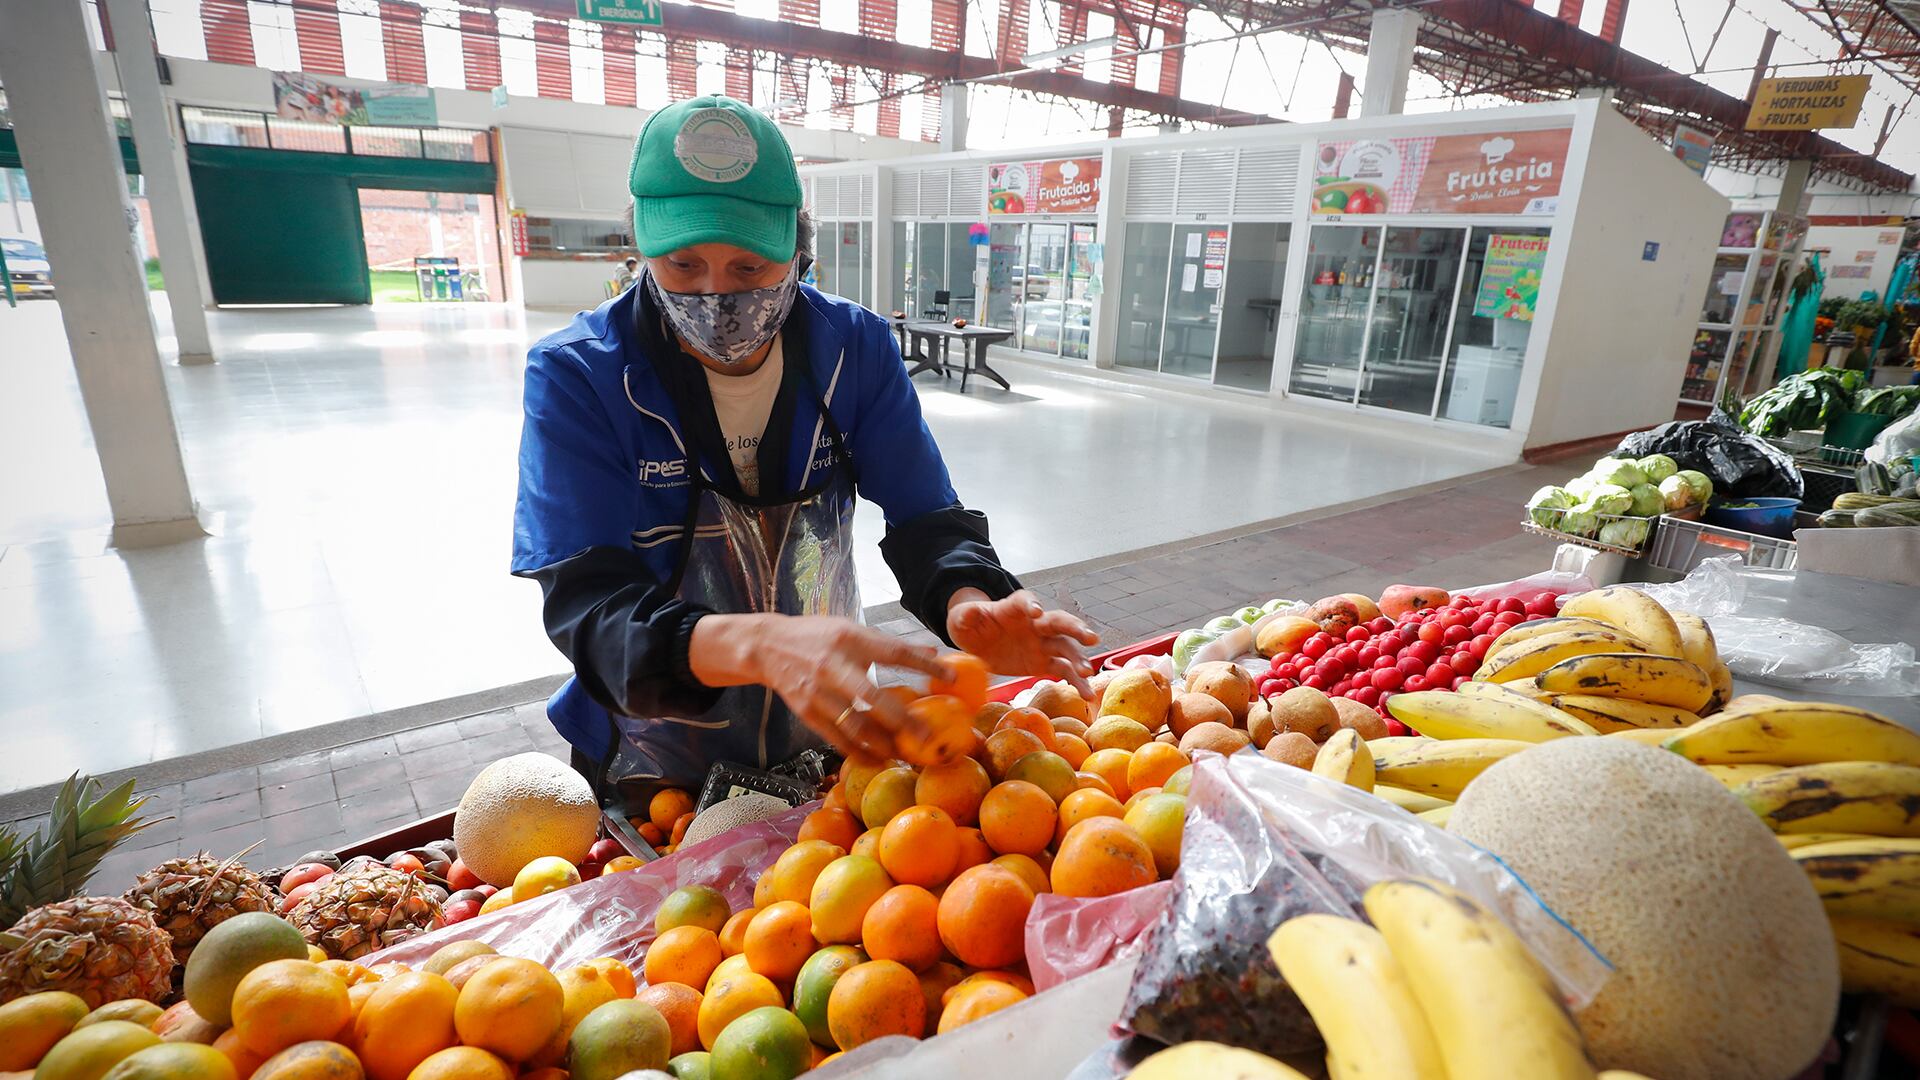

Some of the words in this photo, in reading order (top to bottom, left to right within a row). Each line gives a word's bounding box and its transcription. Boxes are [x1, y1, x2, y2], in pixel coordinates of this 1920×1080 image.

[599, 7, 644, 19] EMERGENCIA
[1776, 80, 1840, 92] VERDURAS
[1770, 95, 1847, 109] HORTALIZAS
[1765, 112, 1811, 125] FRUTAS
[1447, 157, 1552, 192] Fruteria
[1039, 181, 1090, 201] Frutacida
[738, 436, 758, 450] los
